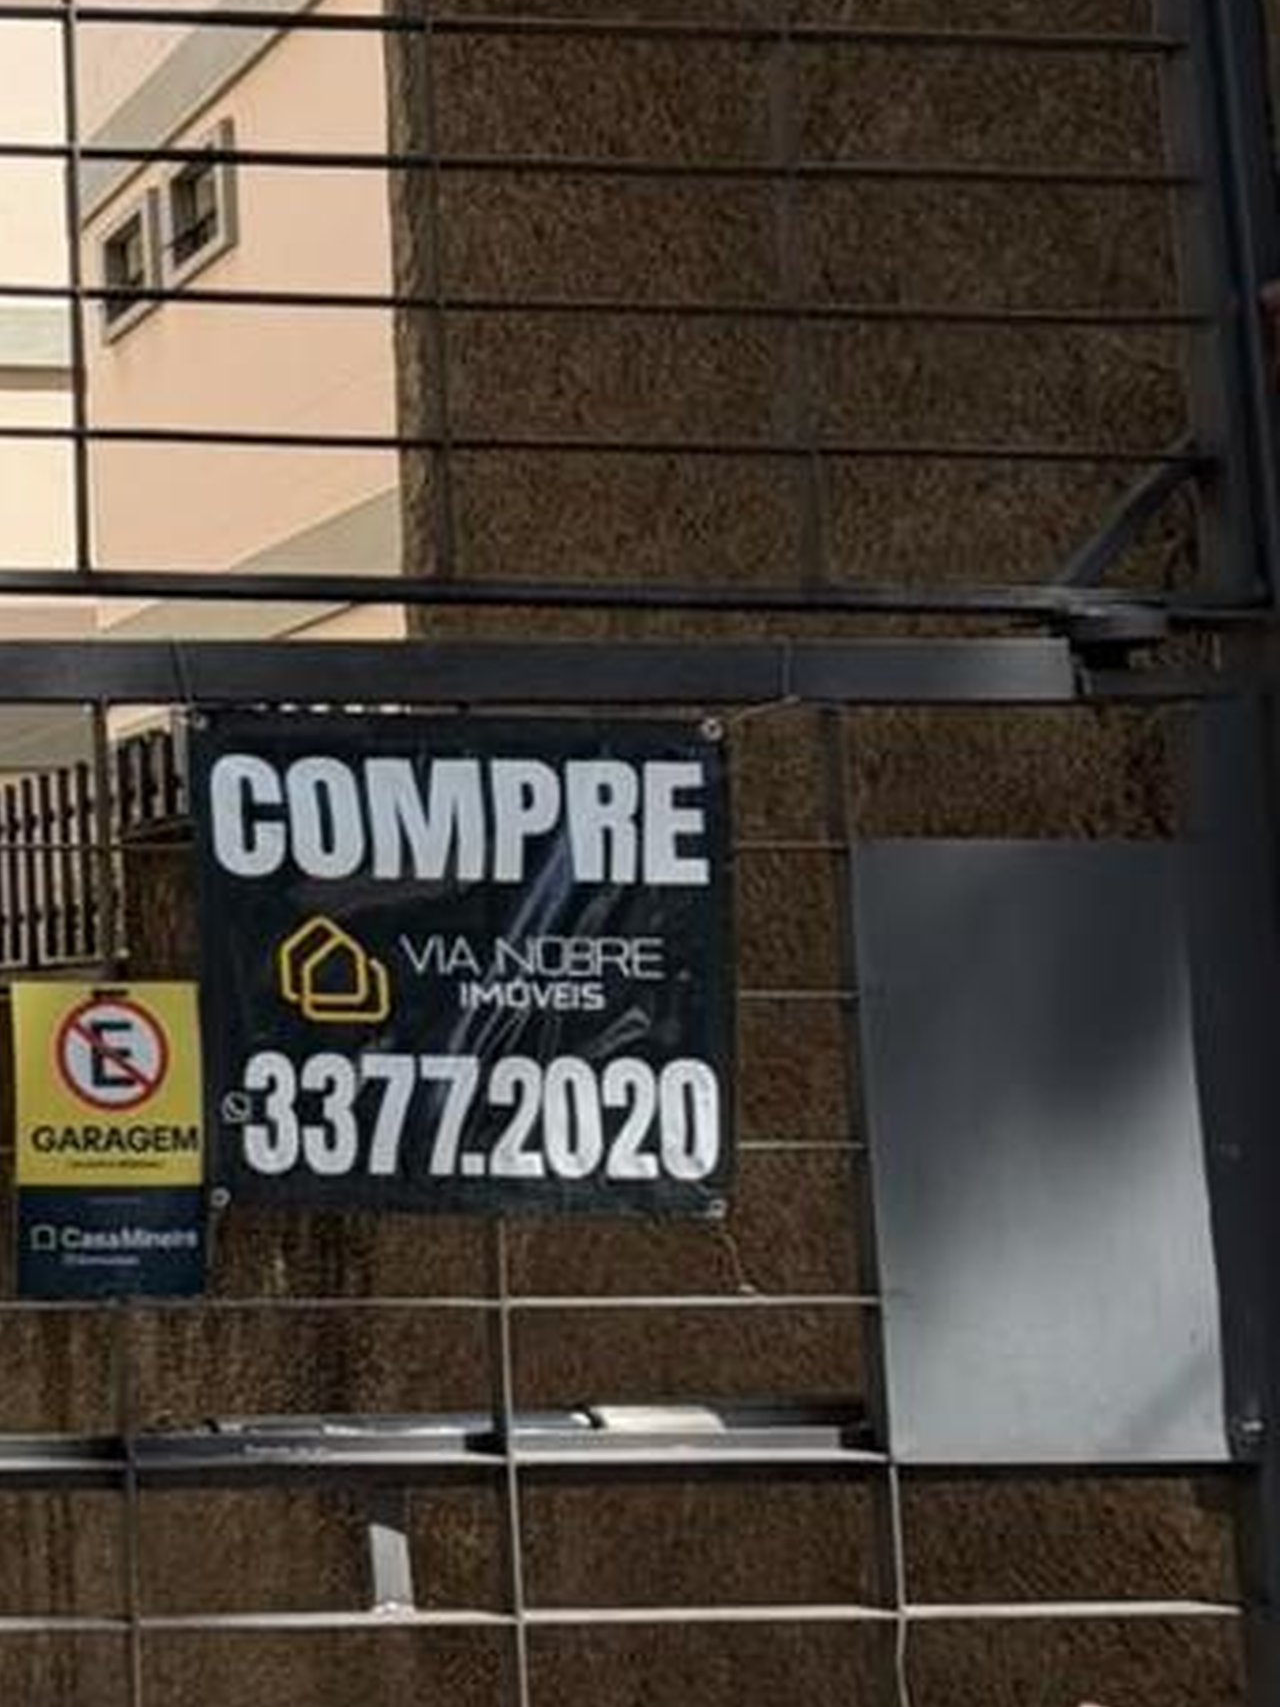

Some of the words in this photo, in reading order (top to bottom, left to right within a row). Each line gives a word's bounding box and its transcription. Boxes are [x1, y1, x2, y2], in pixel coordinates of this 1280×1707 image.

[209, 754, 711, 886] COMPRE
[400, 935, 481, 975] VIA
[495, 937, 666, 979] NOBRE
[31, 1125, 199, 1154] GARAGEM
[243, 1051, 721, 1180] 3377.2020
